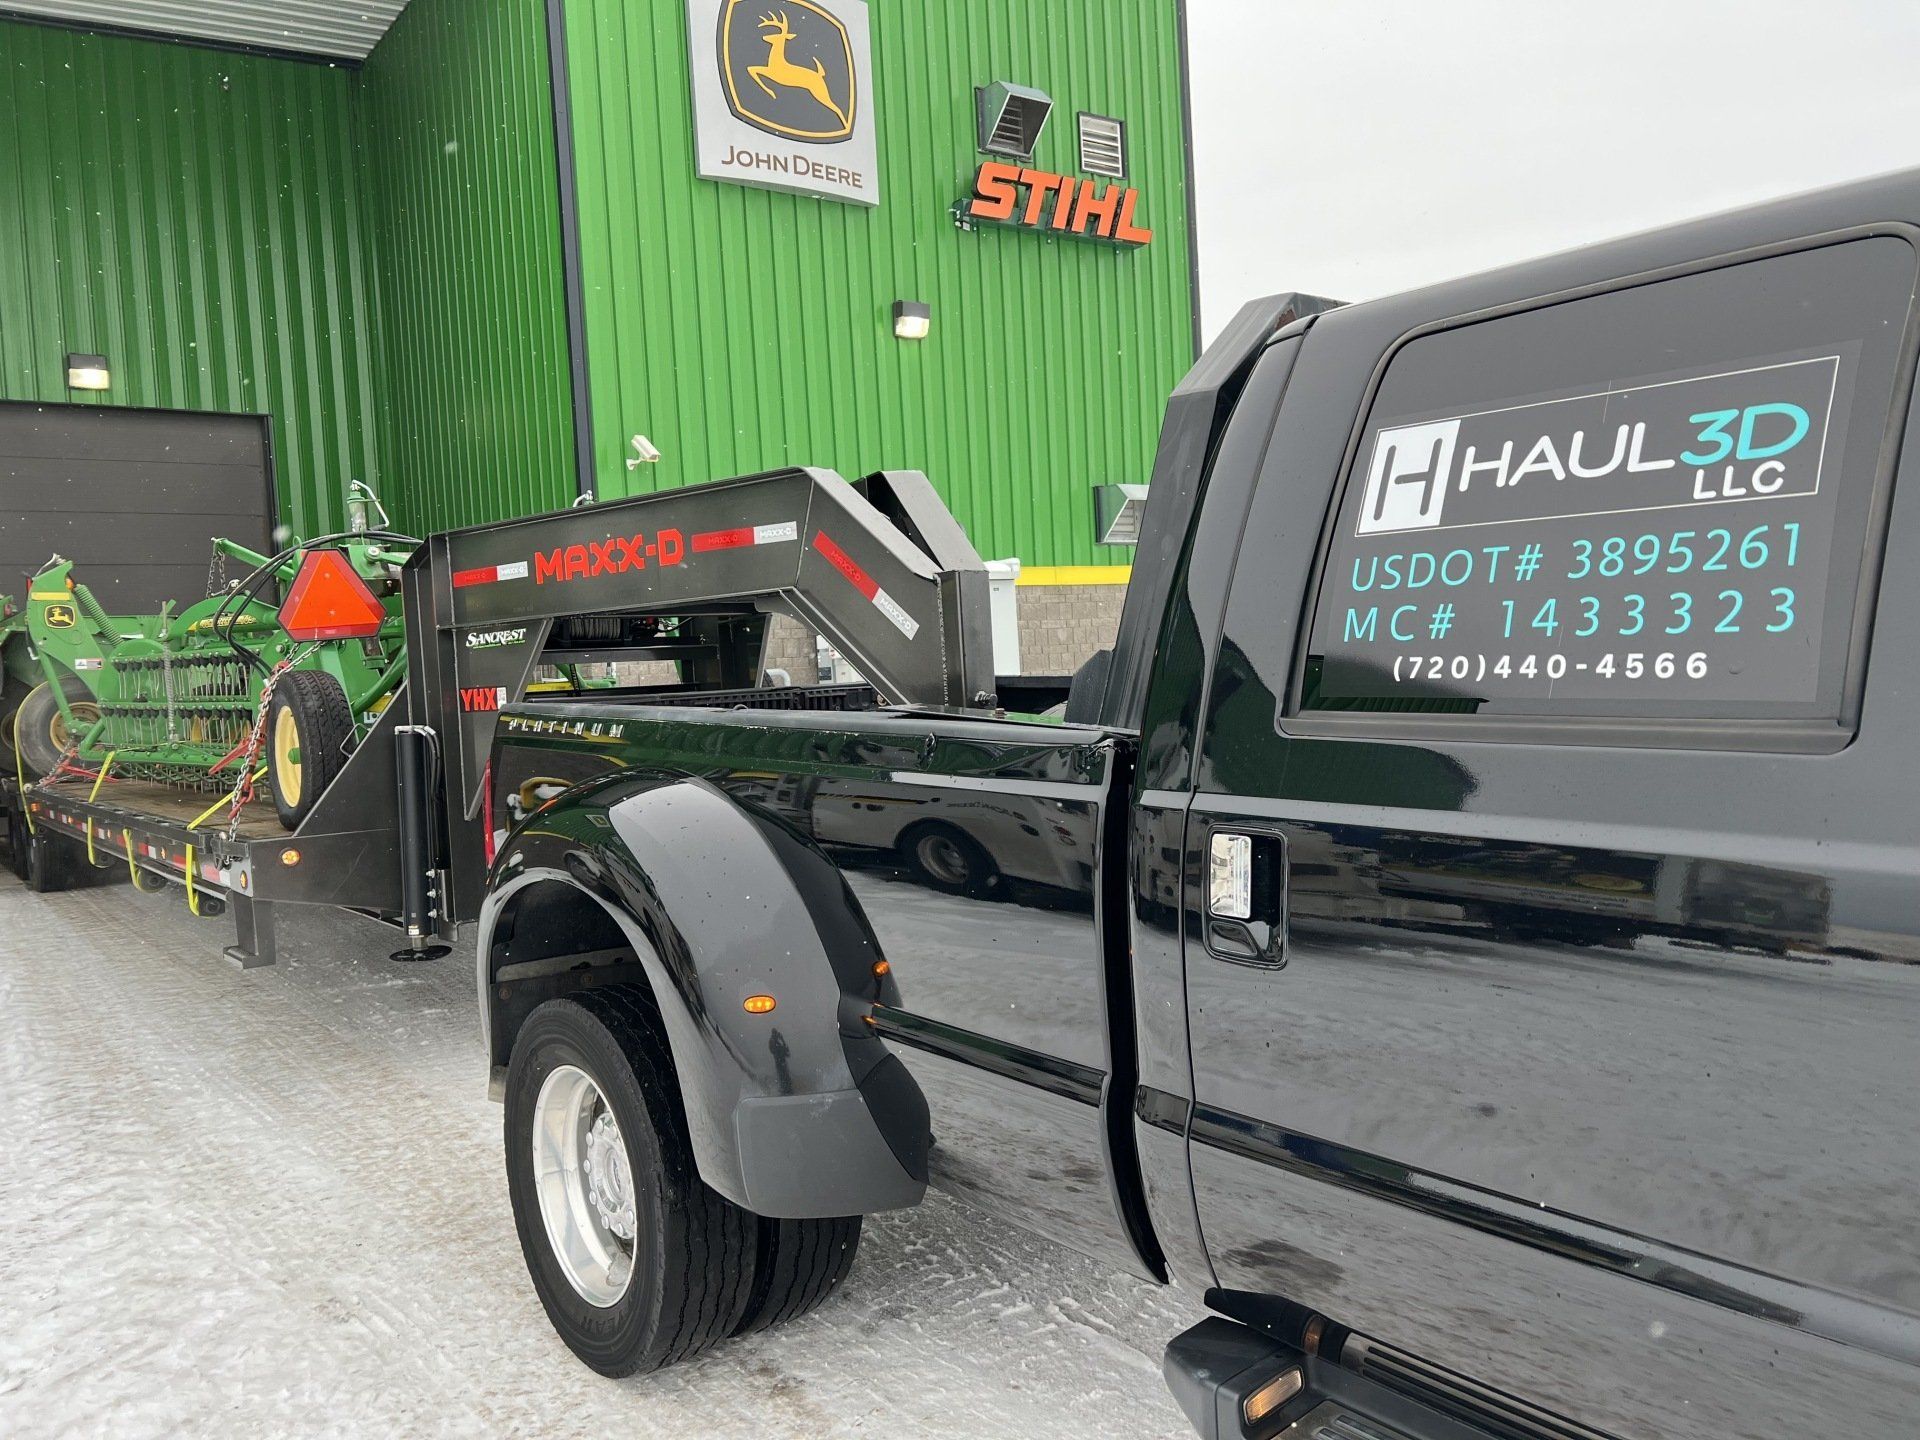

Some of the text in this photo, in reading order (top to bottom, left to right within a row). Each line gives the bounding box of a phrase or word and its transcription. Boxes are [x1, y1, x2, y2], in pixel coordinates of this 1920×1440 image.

[721, 145, 864, 189] JOHN DEERE
[970, 161, 1153, 245] STIHL
[1458, 402, 1810, 492] HAUL 3D
[1692, 460, 1786, 501] LLC
[535, 528, 684, 585] MAXX-D
[1351, 522, 1800, 592] USDOT# 3895261
[1343, 586, 1796, 643] MC# 1433323
[1393, 651, 1708, 682] (720)440-4566
[460, 687, 497, 712] YHX
[508, 719, 625, 738] PLATINUM
